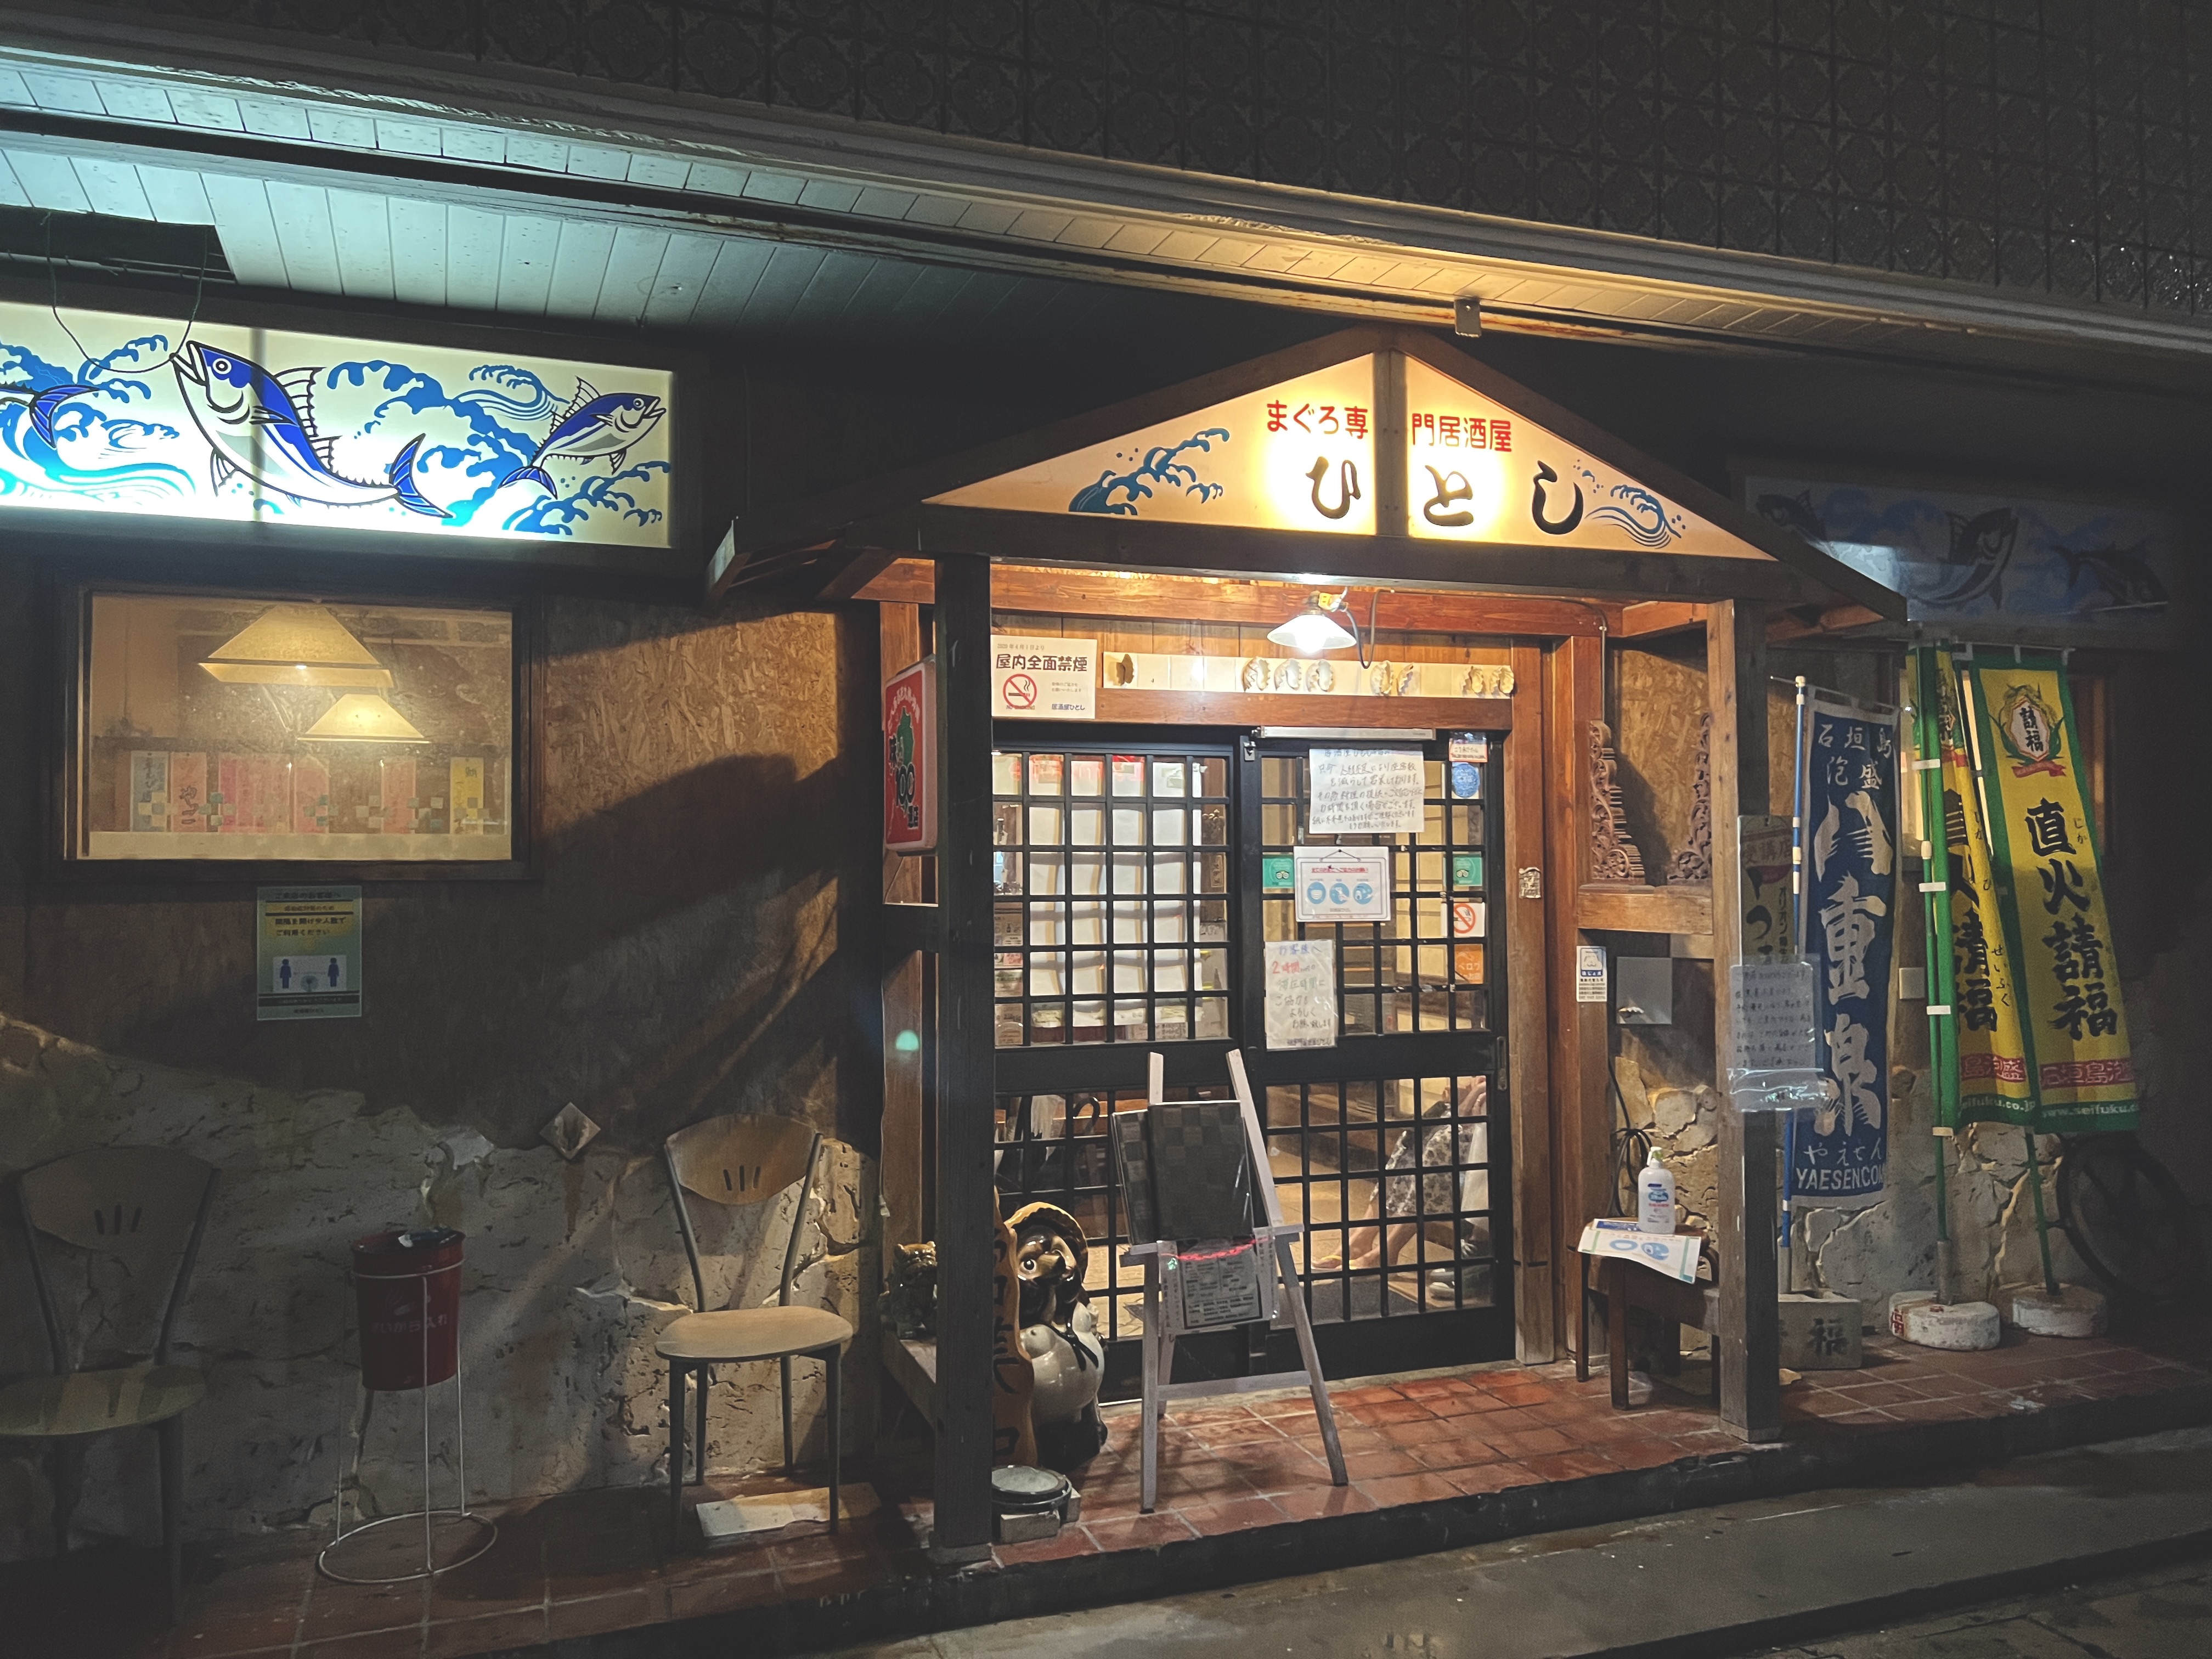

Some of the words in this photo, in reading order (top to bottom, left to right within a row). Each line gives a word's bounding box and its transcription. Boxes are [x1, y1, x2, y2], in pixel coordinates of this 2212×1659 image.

[1266, 399, 1512, 453] まぐろ専門居酒屋
[1305, 455, 1584, 535] ひとし
[996, 653, 1088, 672] 屋内全面禁煙
[1818, 723, 1892, 759] 石垣島
[1826, 756, 1882, 790] 泡盛
[2024, 797, 2119, 1041] 直火請福
[1814, 790, 1894, 1137] 八重泉
[1289, 1007, 1316, 1018] よろしく
